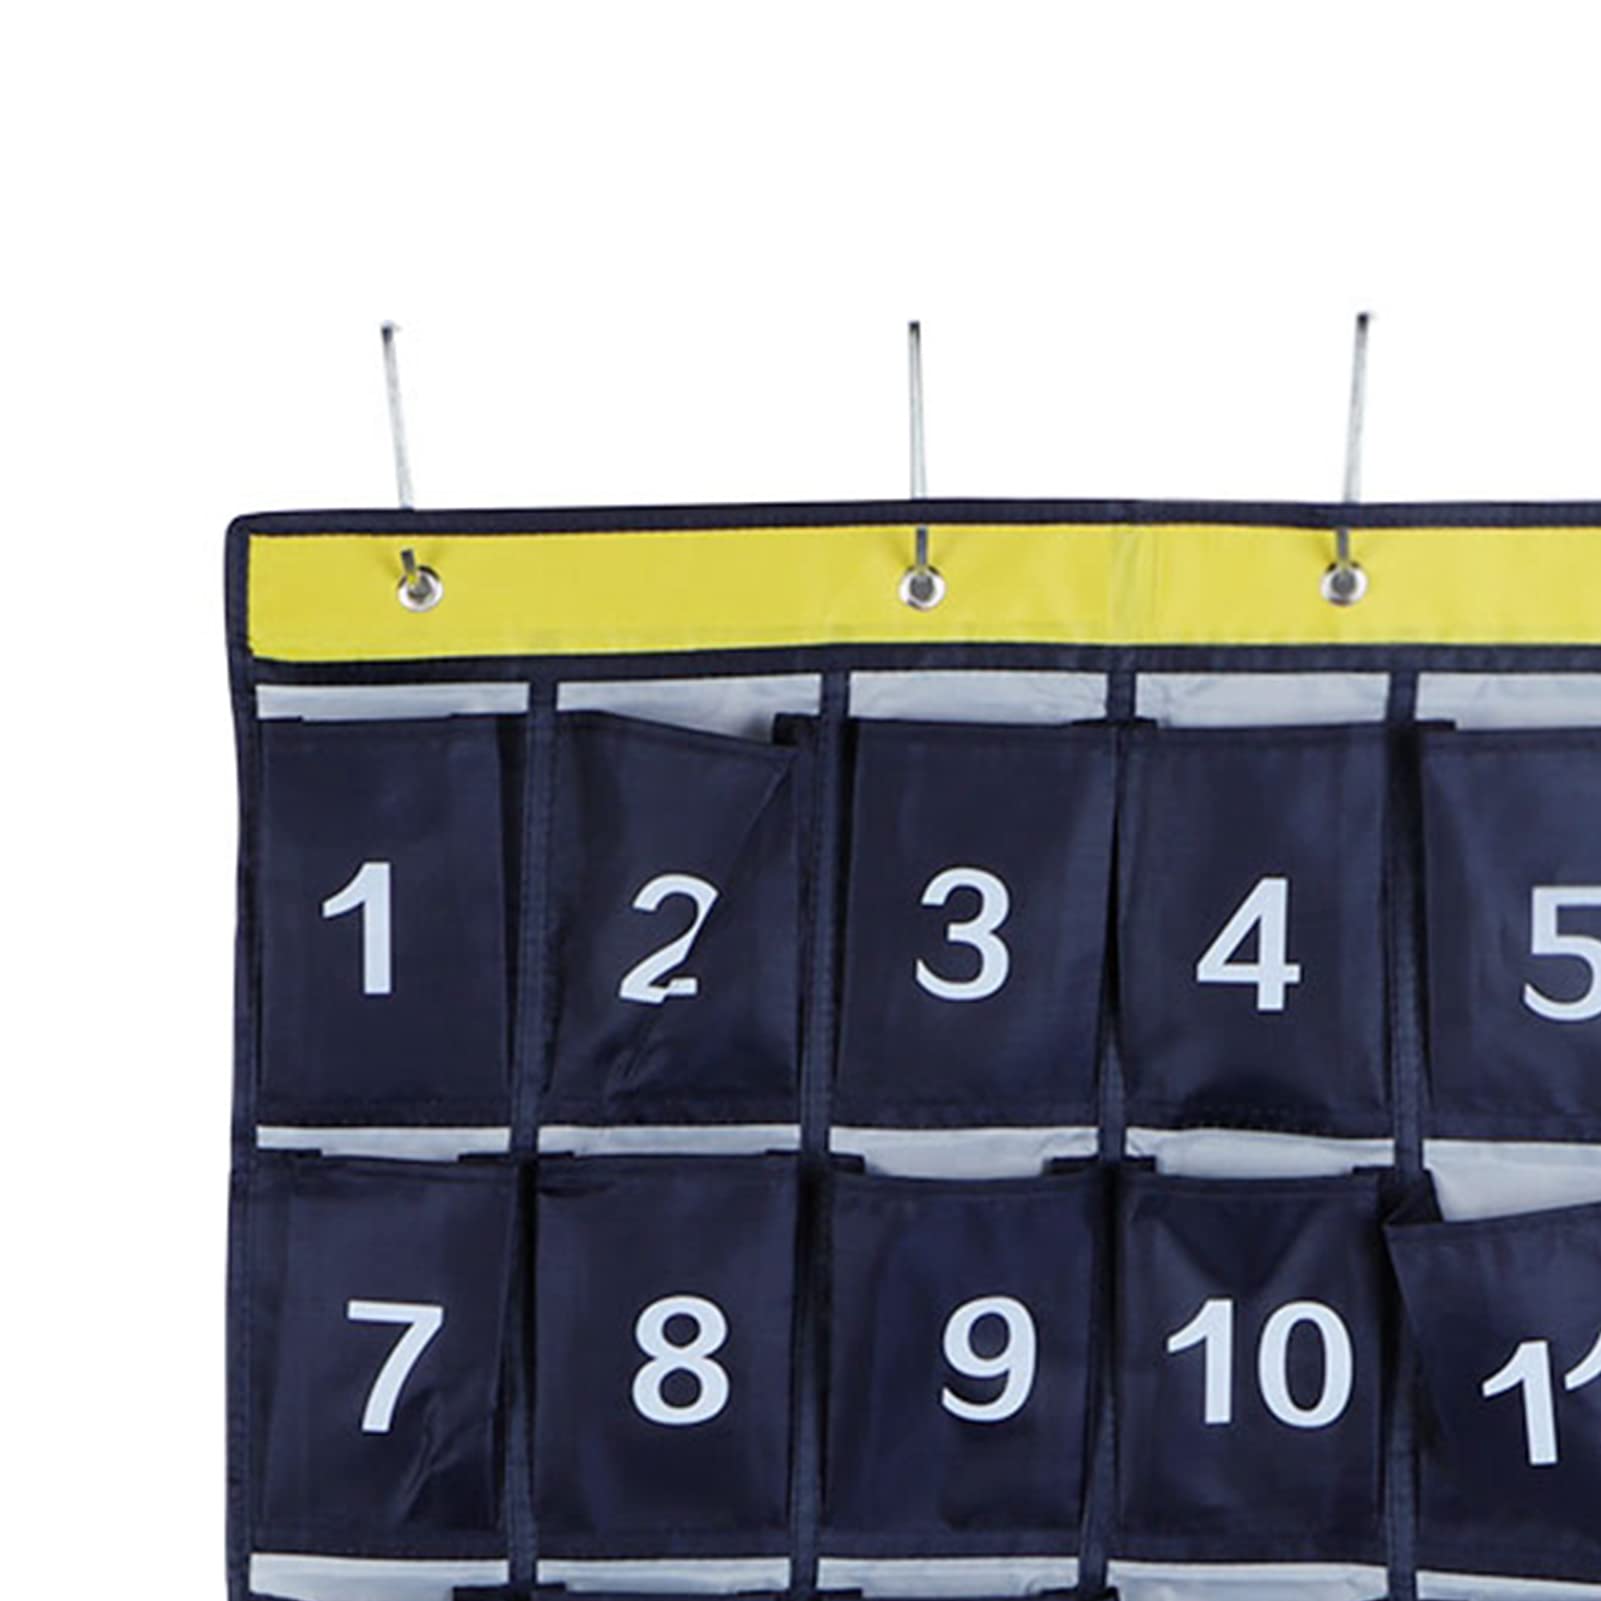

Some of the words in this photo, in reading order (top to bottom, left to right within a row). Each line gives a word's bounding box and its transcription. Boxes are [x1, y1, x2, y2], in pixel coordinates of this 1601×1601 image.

[323, 862, 391, 994] 1
[619, 874, 718, 1003] 2
[916, 868, 1009, 1000] 3
[1197, 878, 1301, 1010] 4
[1524, 886, 1601, 1021] 5
[347, 1300, 443, 1432] 7
[633, 1296, 729, 1424] 8
[942, 1297, 1036, 1421] 9
[1167, 1299, 1352, 1427] 10
[1482, 1335, 1601, 1465] 1
